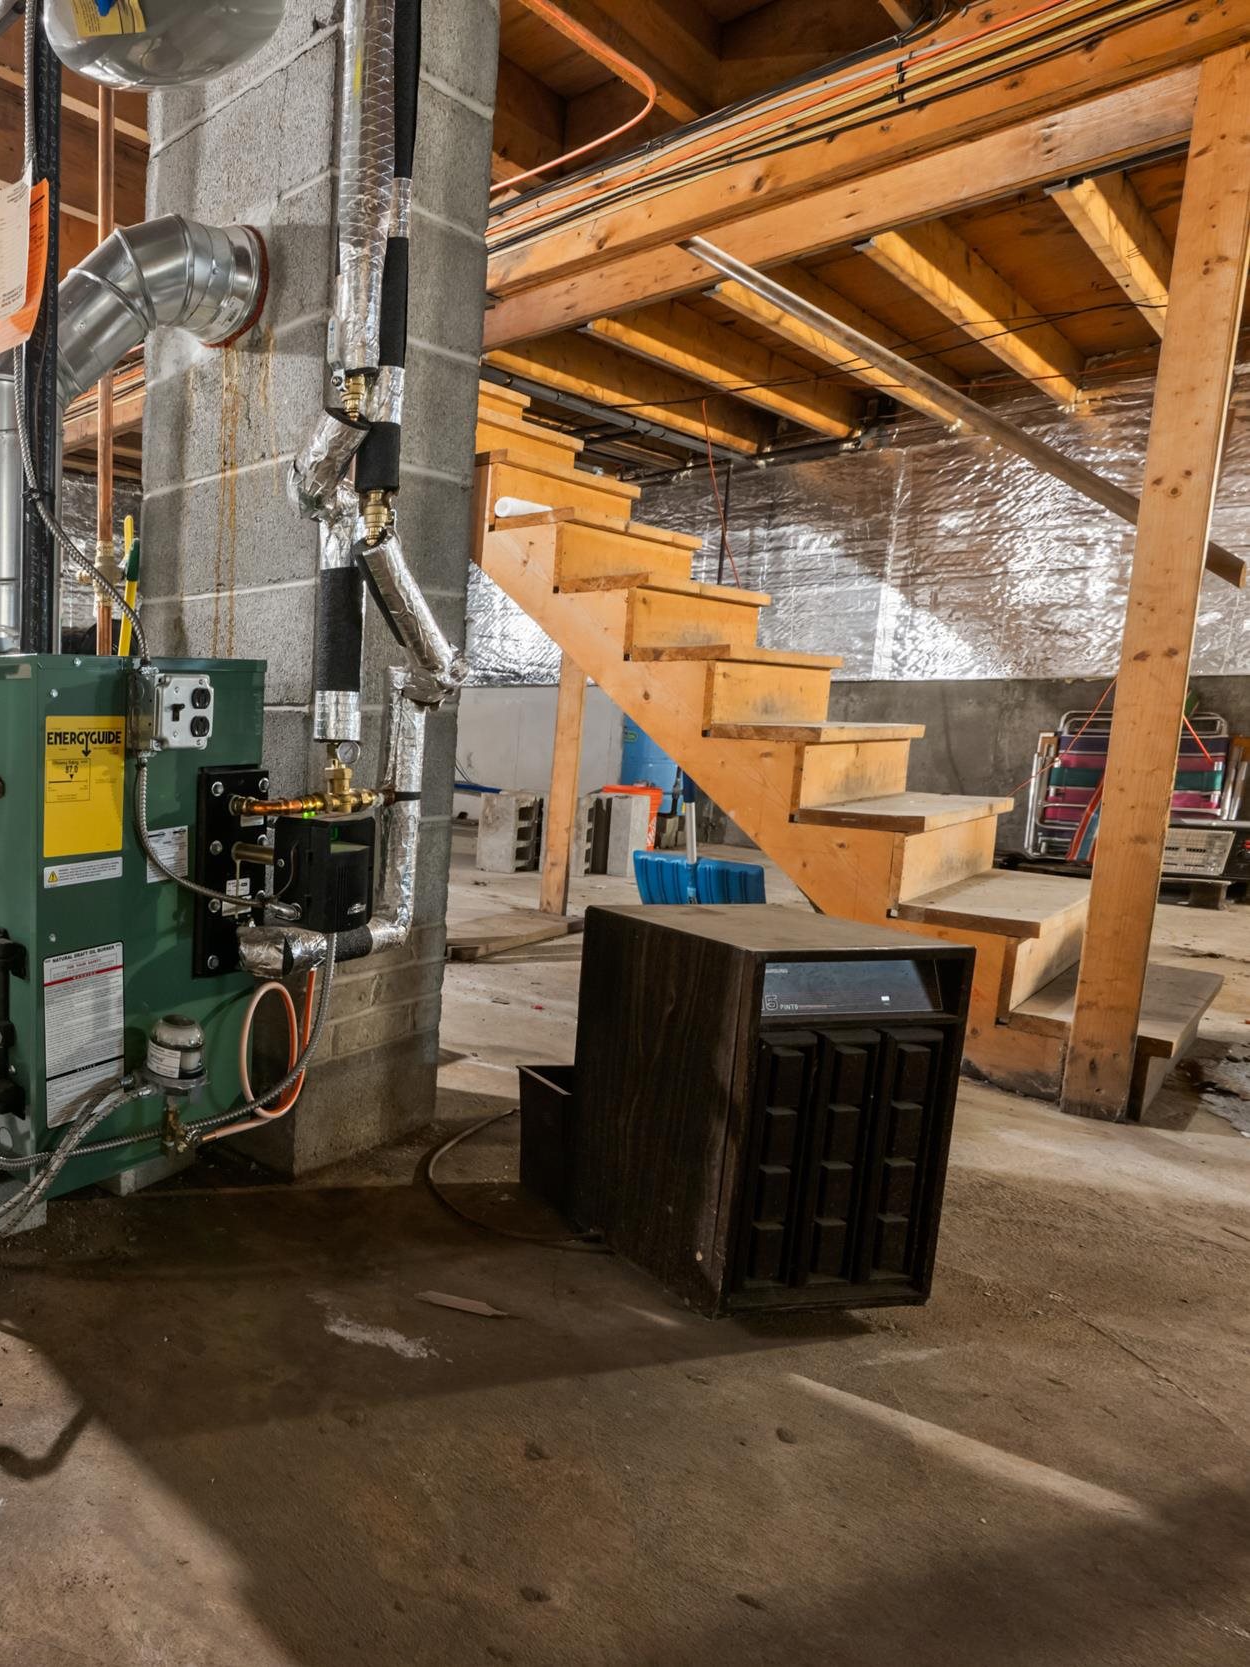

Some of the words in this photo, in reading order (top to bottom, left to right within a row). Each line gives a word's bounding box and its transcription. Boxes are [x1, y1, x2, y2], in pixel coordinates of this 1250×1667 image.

[47, 731, 122, 747] ENERGYGUIDE
[52, 954, 72, 963] NATURAL
[74, 950, 88, 959] DRAFT
[97, 945, 115, 953] BURNER
